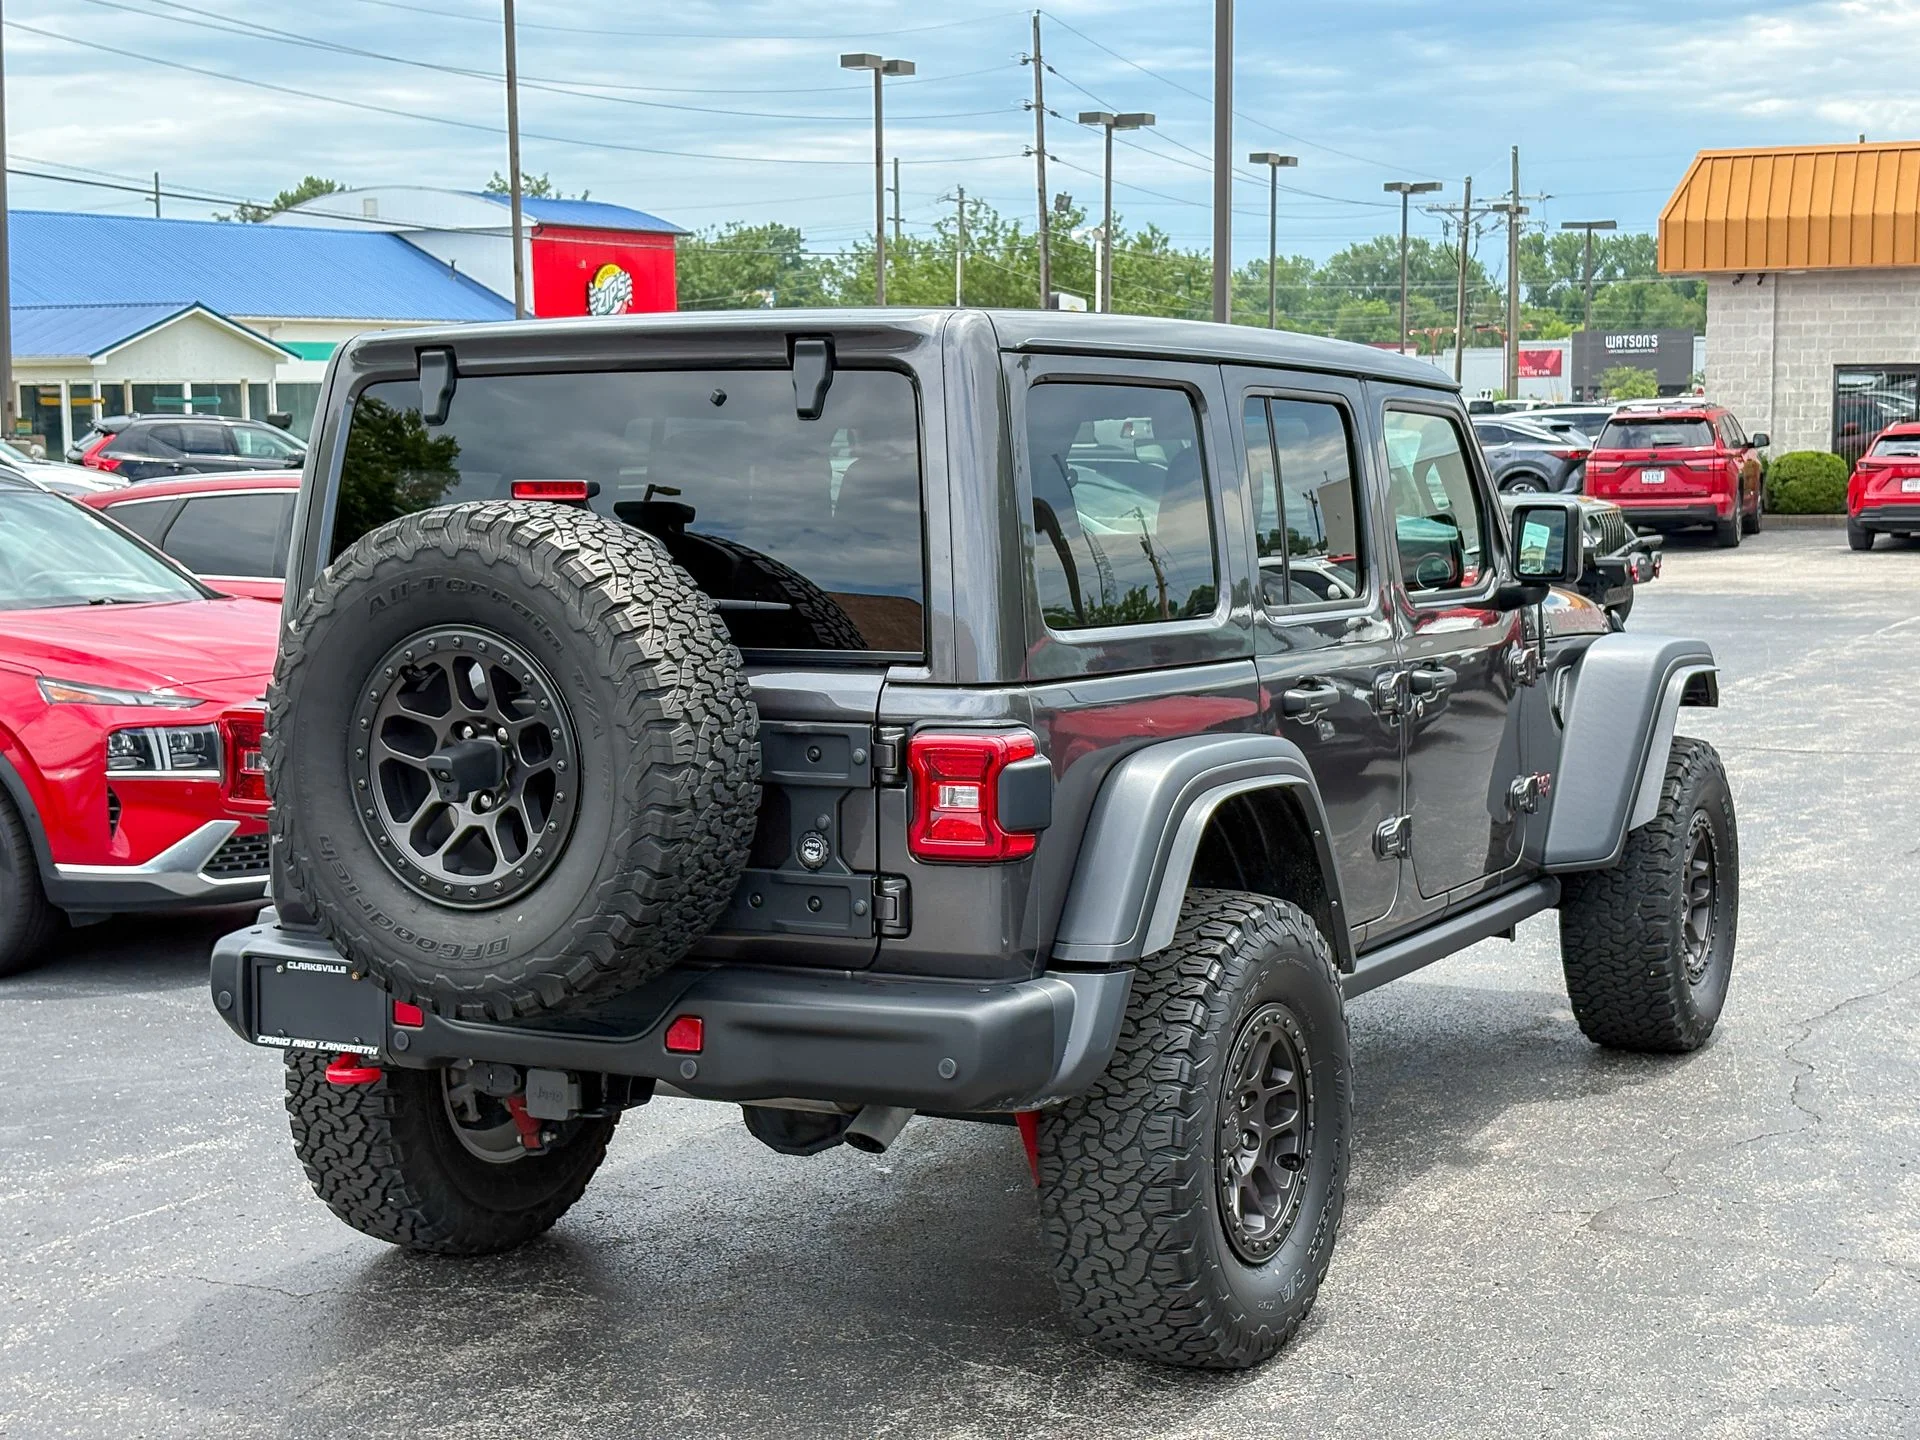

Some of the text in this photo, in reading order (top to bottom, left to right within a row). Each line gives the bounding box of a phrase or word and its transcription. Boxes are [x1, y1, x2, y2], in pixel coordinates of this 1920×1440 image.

[596, 273, 627, 314] ZIPS
[1605, 334, 1658, 348] WATSON'S
[804, 840, 820, 849] Jeep
[286, 961, 347, 974] CLARKSVILLE
[292, 1039, 317, 1049] AND
